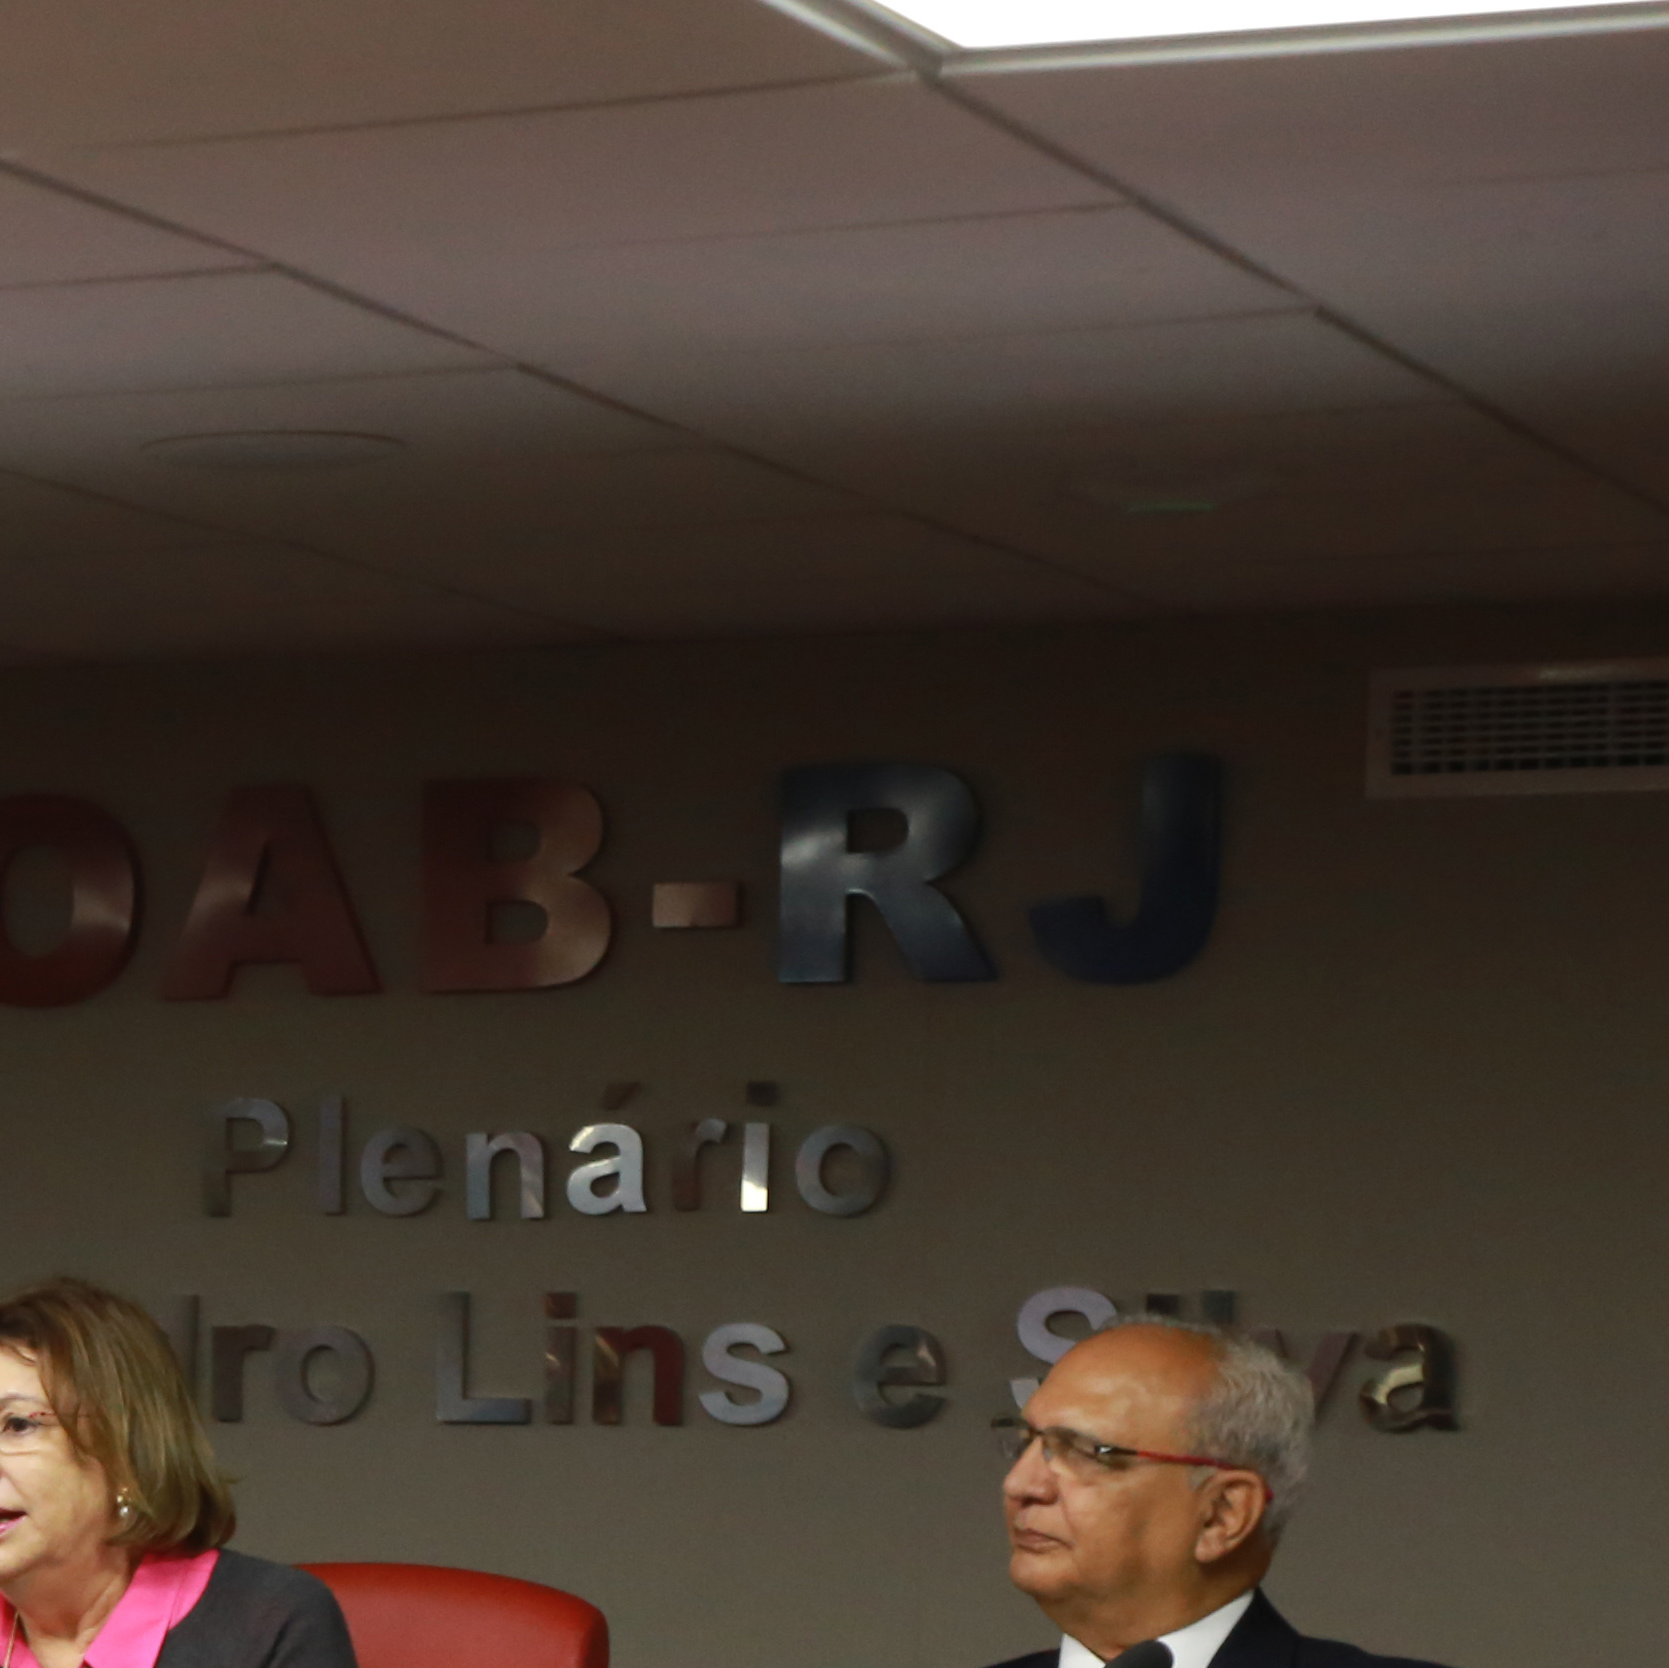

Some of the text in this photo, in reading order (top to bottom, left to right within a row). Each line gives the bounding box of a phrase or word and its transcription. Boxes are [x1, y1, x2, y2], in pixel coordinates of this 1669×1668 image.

[201, 1081, 893, 1220] Plenário
[437, 1289, 788, 1428] Lins
[851, 1325, 948, 1428] e
